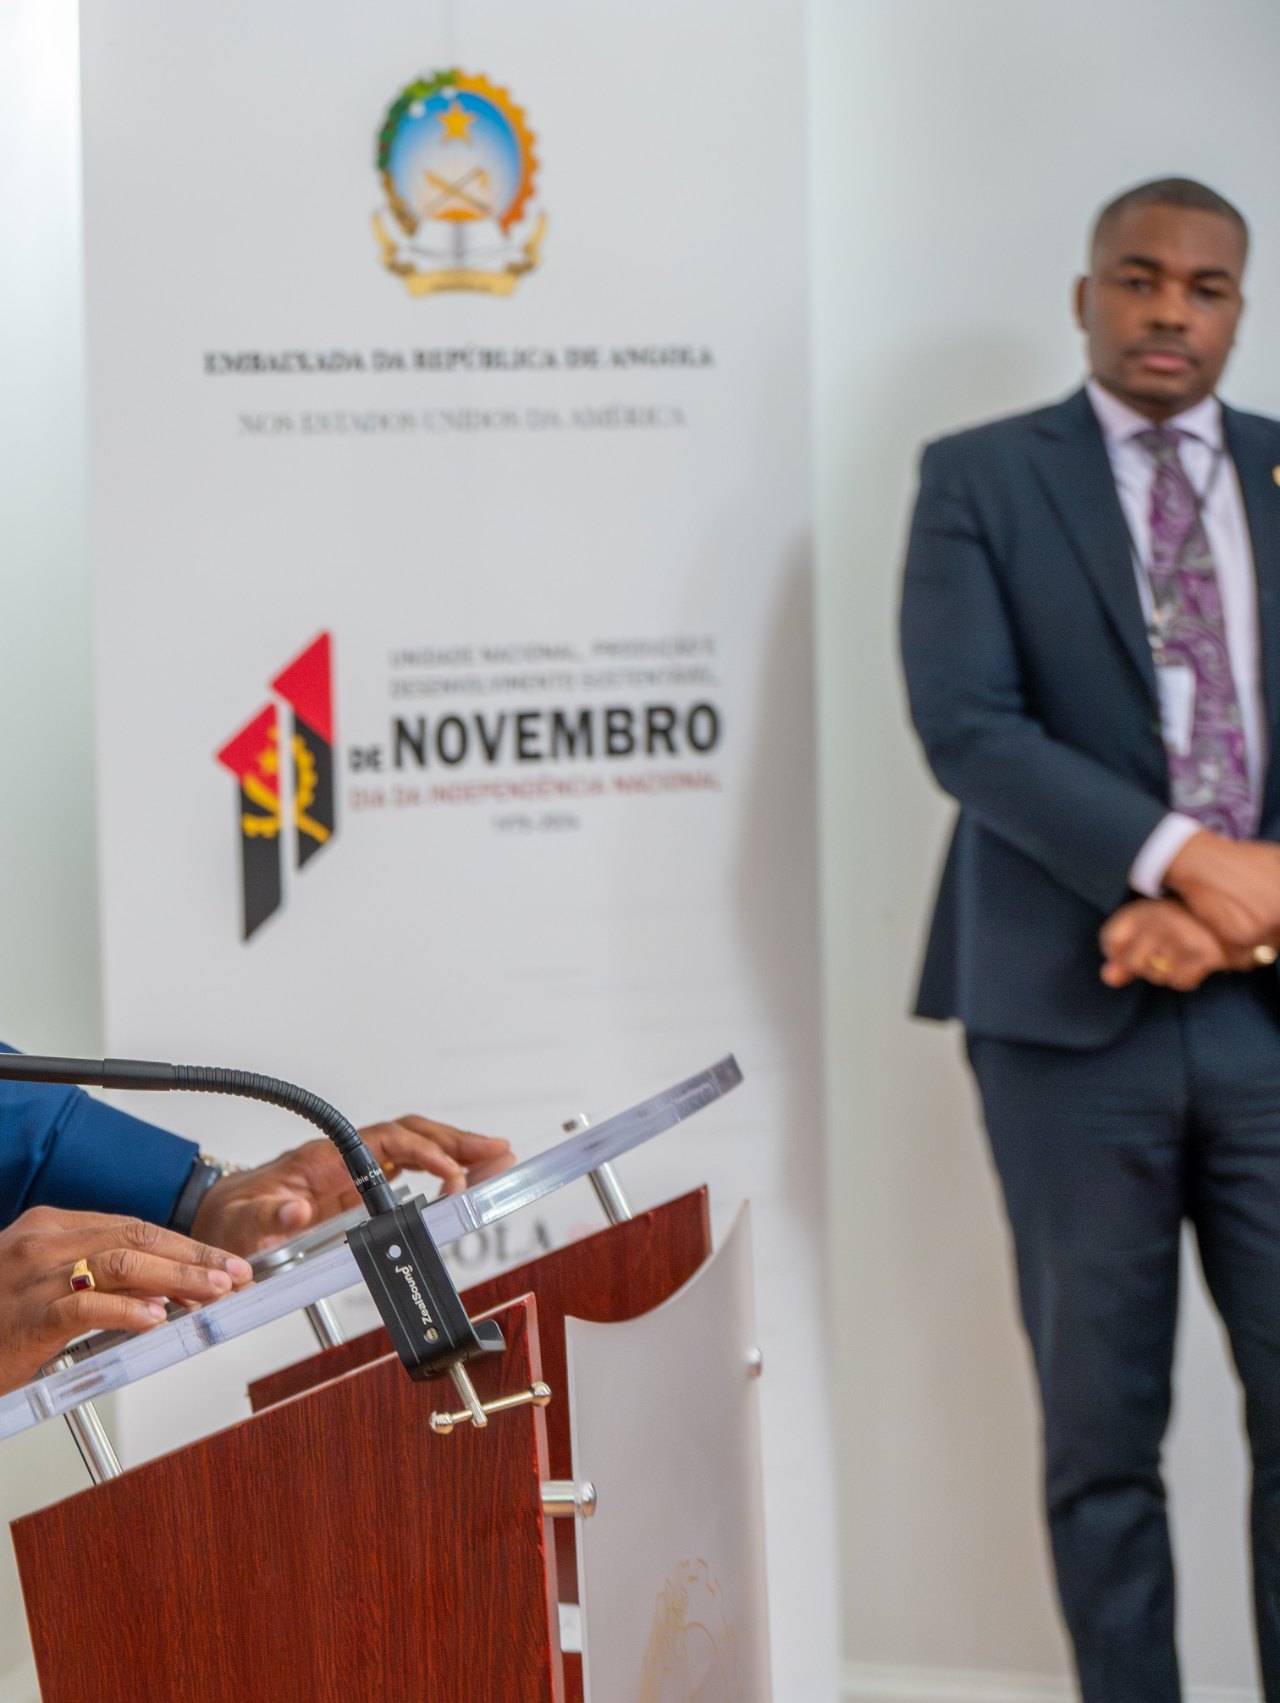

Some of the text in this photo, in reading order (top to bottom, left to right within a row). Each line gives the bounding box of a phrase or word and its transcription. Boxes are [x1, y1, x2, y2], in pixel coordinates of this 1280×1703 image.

[205, 350, 365, 375] EMBAIXADA
[372, 350, 406, 372] DA
[565, 348, 599, 370] DE
[612, 347, 716, 369] ANGOLA
[350, 745, 382, 773] DE
[393, 703, 723, 770] NOVEMBRO
[395, 1265, 433, 1325] ZealSound
